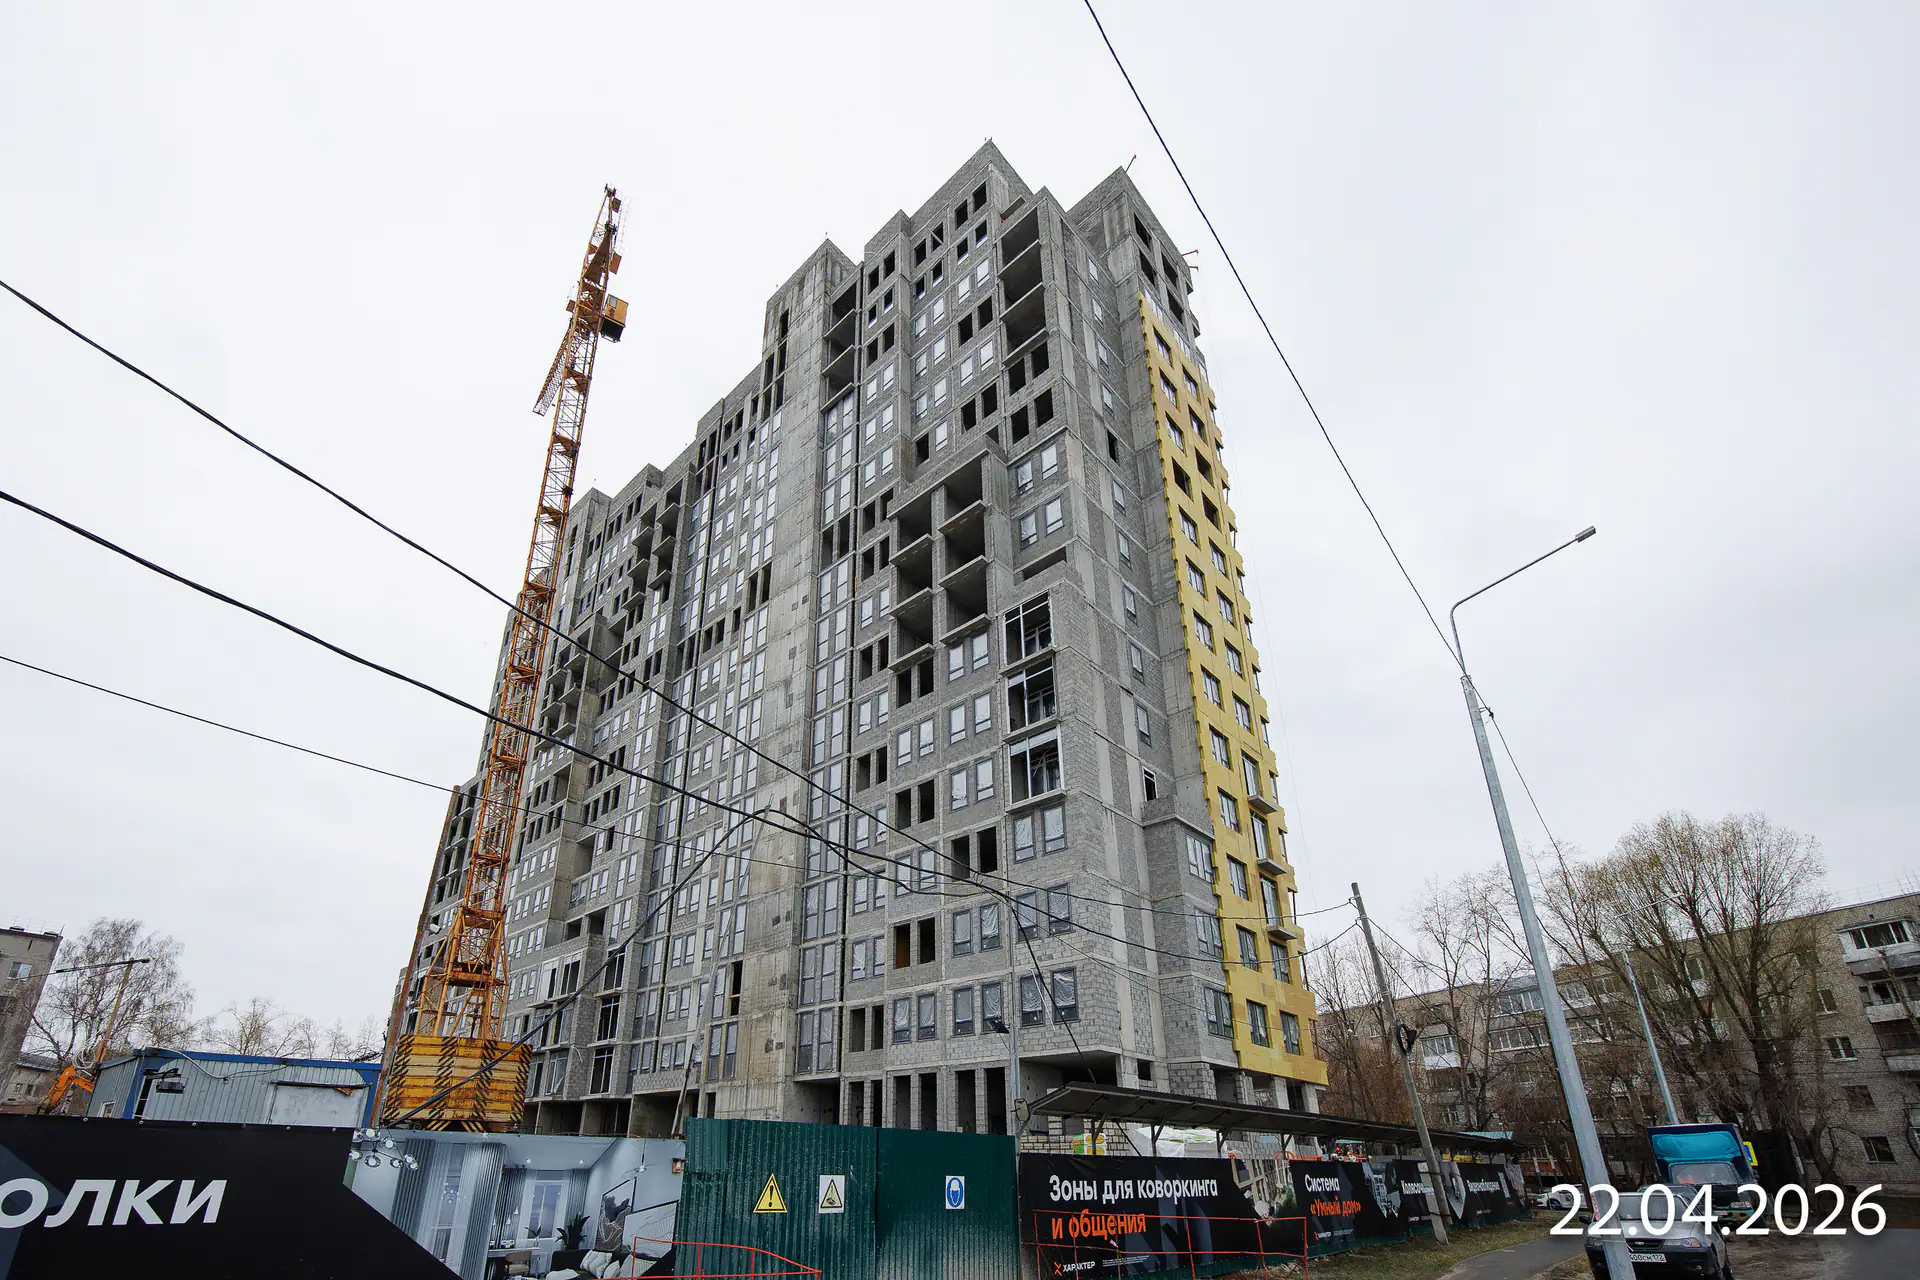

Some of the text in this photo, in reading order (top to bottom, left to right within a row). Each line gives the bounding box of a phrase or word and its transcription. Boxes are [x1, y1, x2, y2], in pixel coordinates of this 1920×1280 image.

[1049, 1174, 1219, 1205] Зоны для коворкинга
[1304, 1173, 1340, 1192] Система
[1310, 1195, 1362, 1217] «Умный дом»
[1051, 1208, 1147, 1241] и общения
[1062, 1261, 1096, 1272] ХАРАКТЕР
